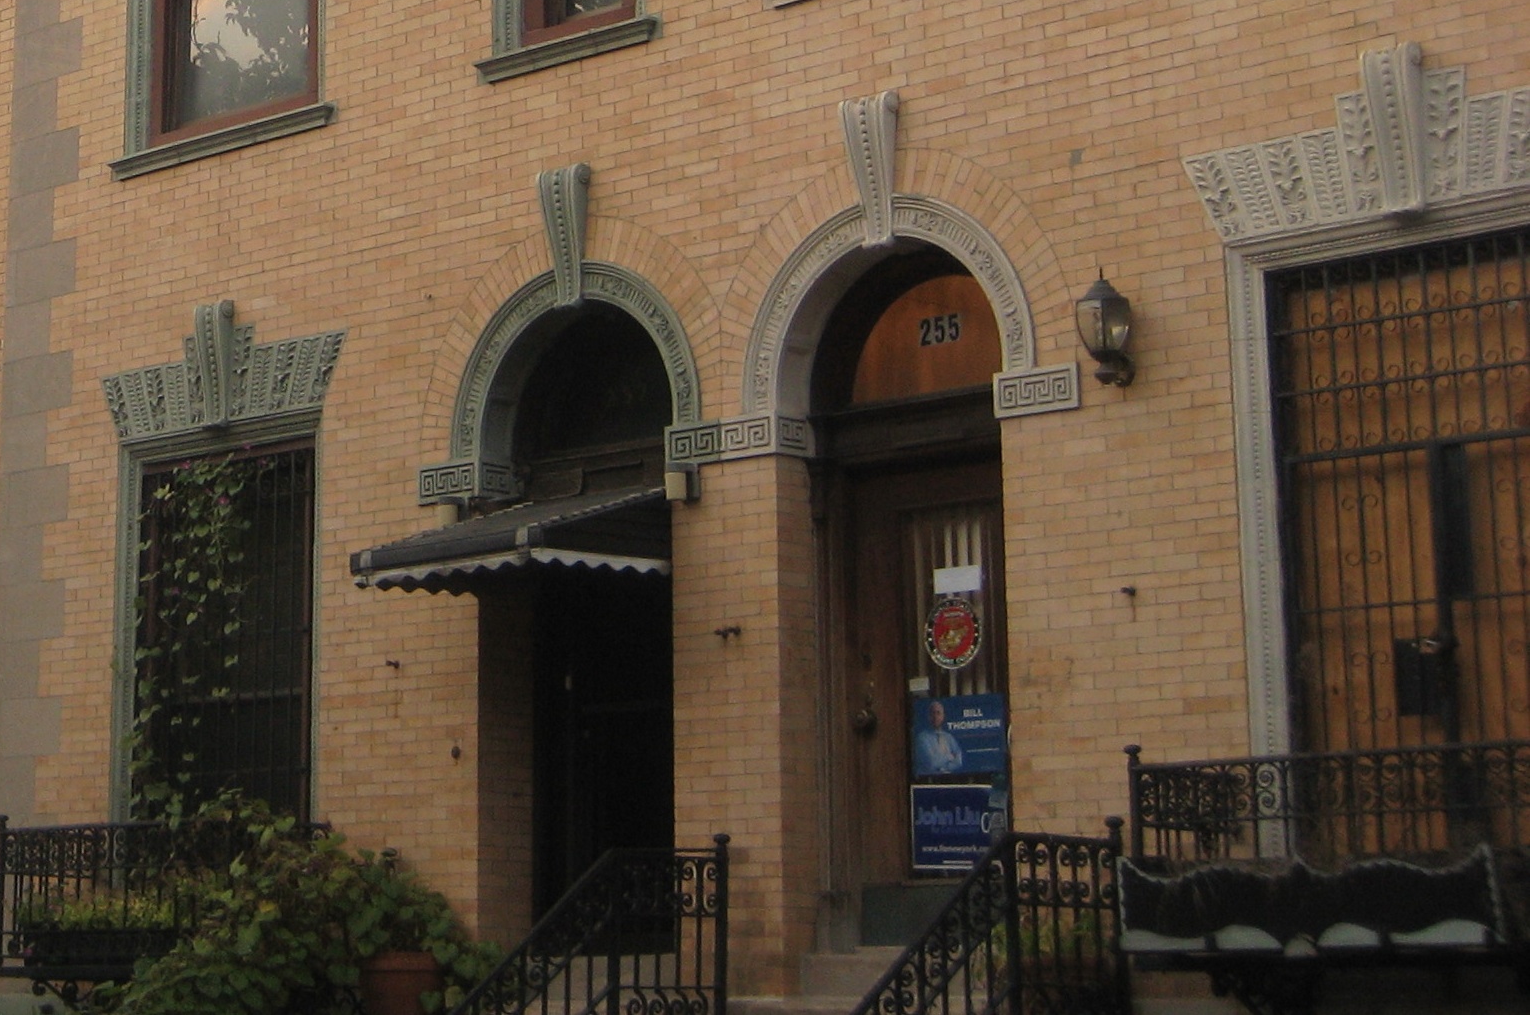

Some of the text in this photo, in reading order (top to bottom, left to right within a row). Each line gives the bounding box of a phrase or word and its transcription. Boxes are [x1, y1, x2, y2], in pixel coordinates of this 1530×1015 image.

[919, 314, 960, 346] 255
[963, 709, 983, 718] BILL
[947, 719, 1001, 730] THOMPSON
[915, 806, 954, 825] John
